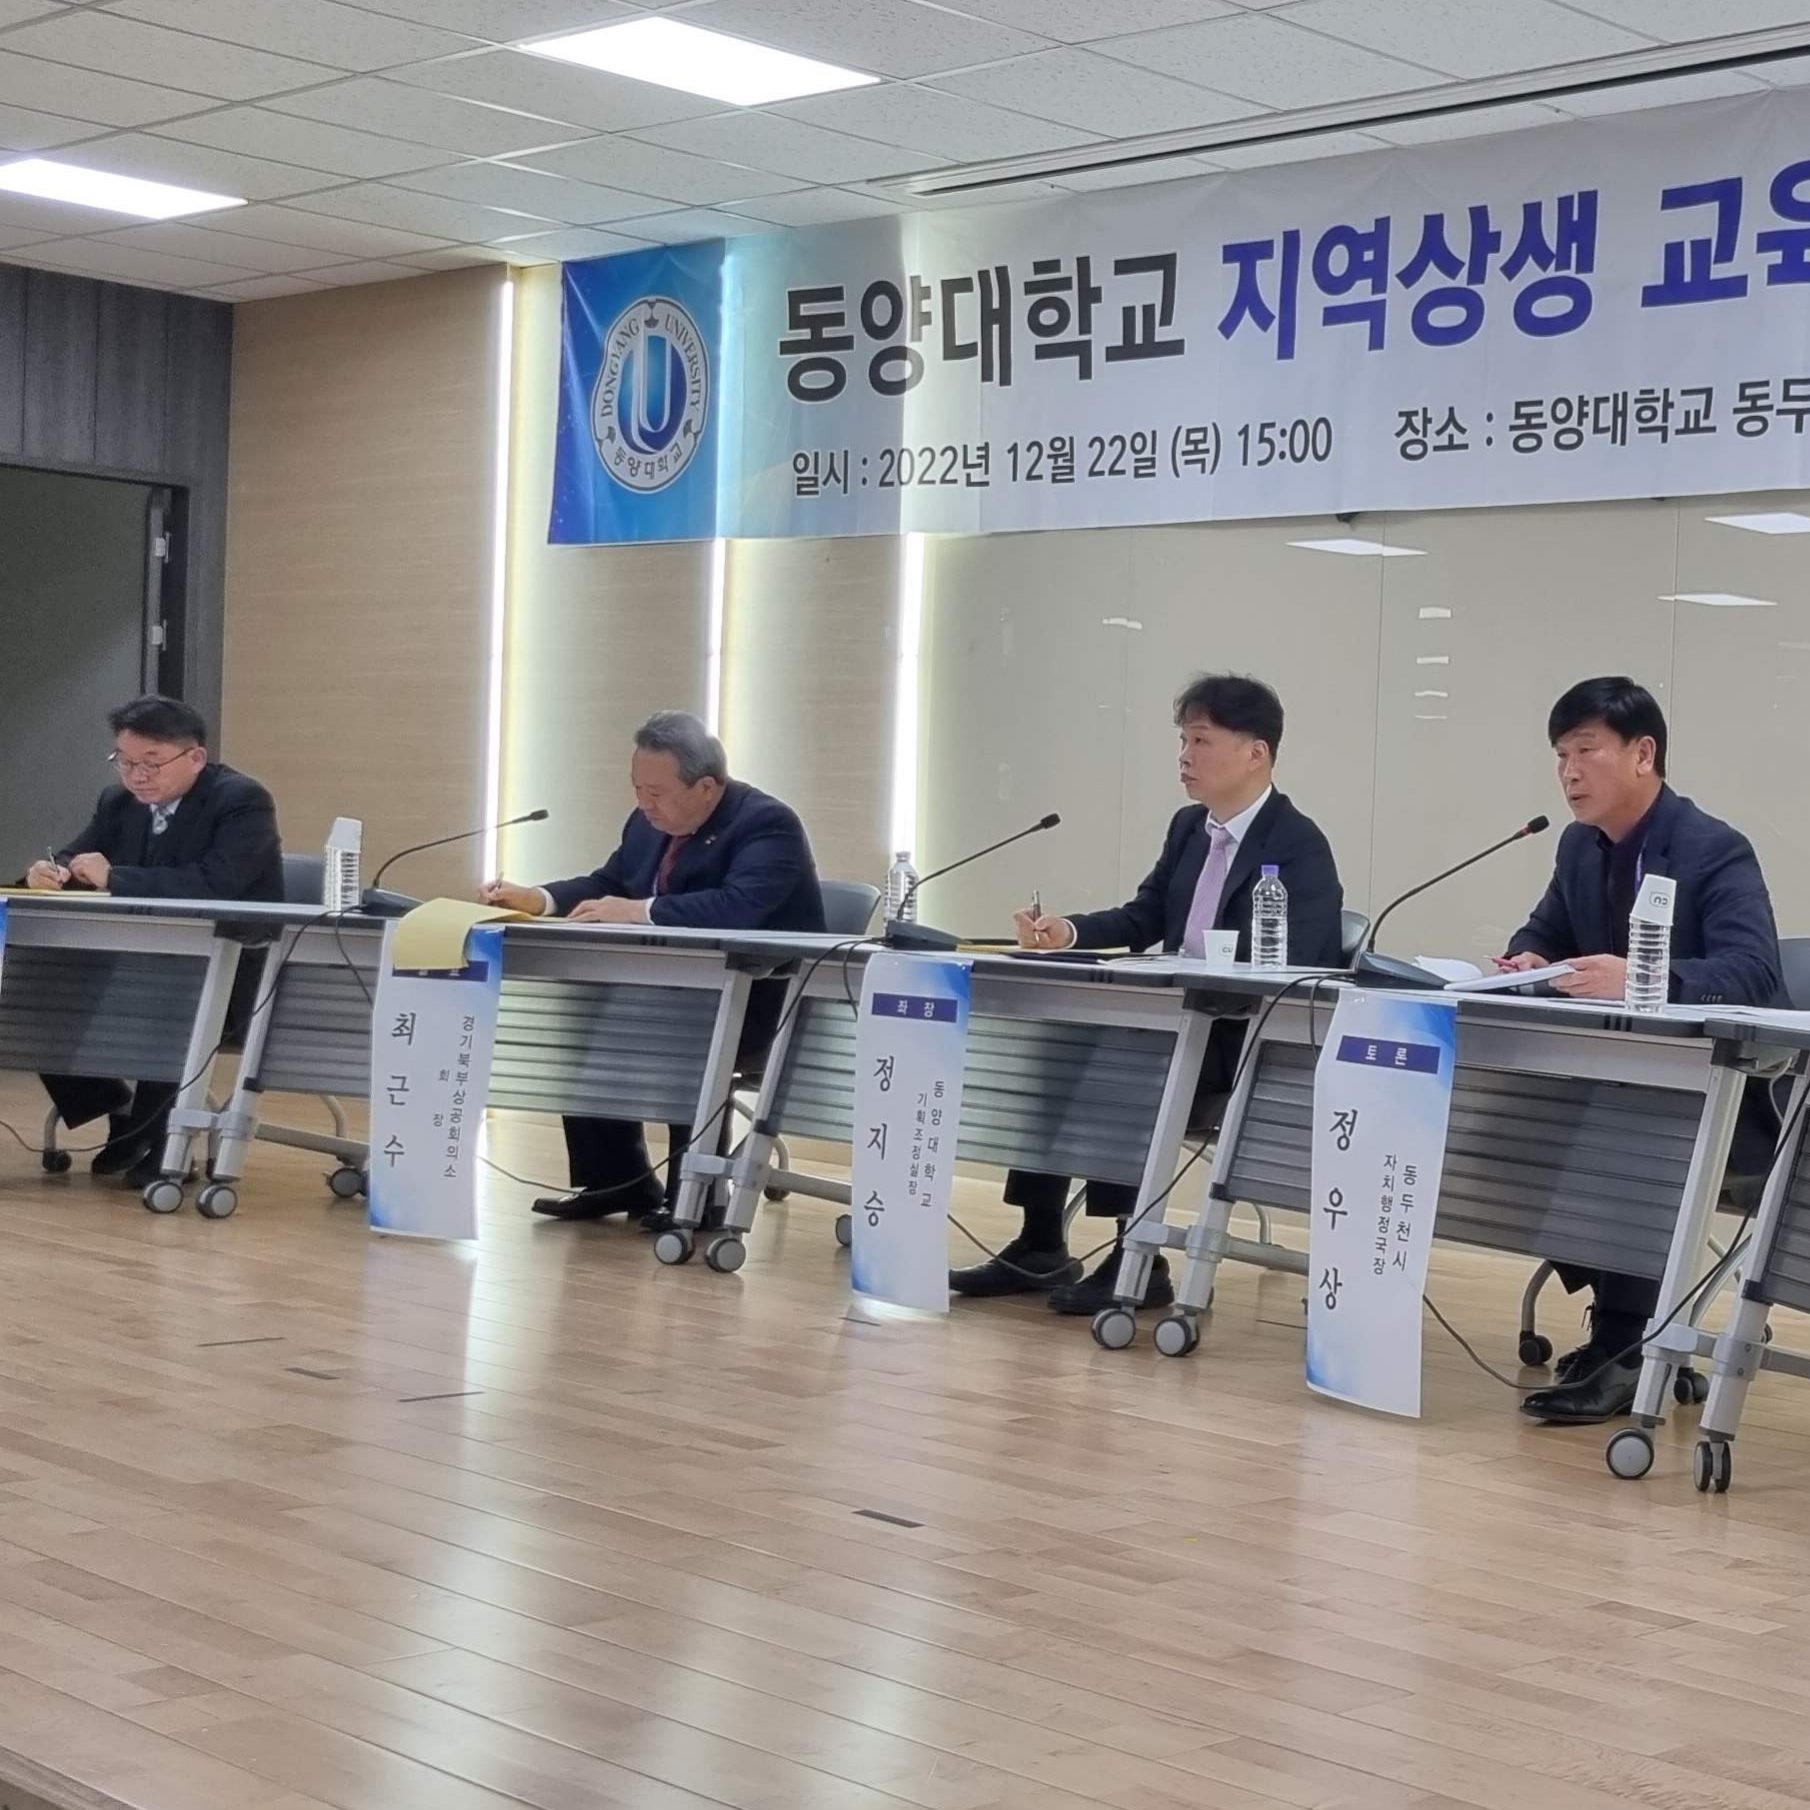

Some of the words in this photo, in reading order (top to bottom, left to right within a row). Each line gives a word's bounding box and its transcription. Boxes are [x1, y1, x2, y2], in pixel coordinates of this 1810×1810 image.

[779, 251, 1185, 401] 동양대학교
[1217, 189, 1599, 360] 지역상생
[601, 318, 640, 417] DONGYANG
[664, 313, 701, 413] UNIVERSITY
[614, 442, 683, 480] 동양대학교
[878, 440, 991, 489] 2022년
[1008, 435, 1077, 484] 12월
[1087, 429, 1159, 479] 22일
[1170, 423, 1222, 479] (목)
[1236, 416, 1333, 469] 15:00
[1394, 405, 1470, 461] 장소
[1508, 385, 1718, 453] 동양대학교
[384, 1012, 416, 1168] 최근수
[444, 1016, 475, 1178] 경기북부상공회의소
[864, 1055, 895, 1228] 정지승
[920, 1080, 944, 1208] 동양대학교
[1319, 1109, 1358, 1311] 정우상
[1373, 1153, 1397, 1276] 자치행정국장
[1392, 1165, 1418, 1272] 동두천시
